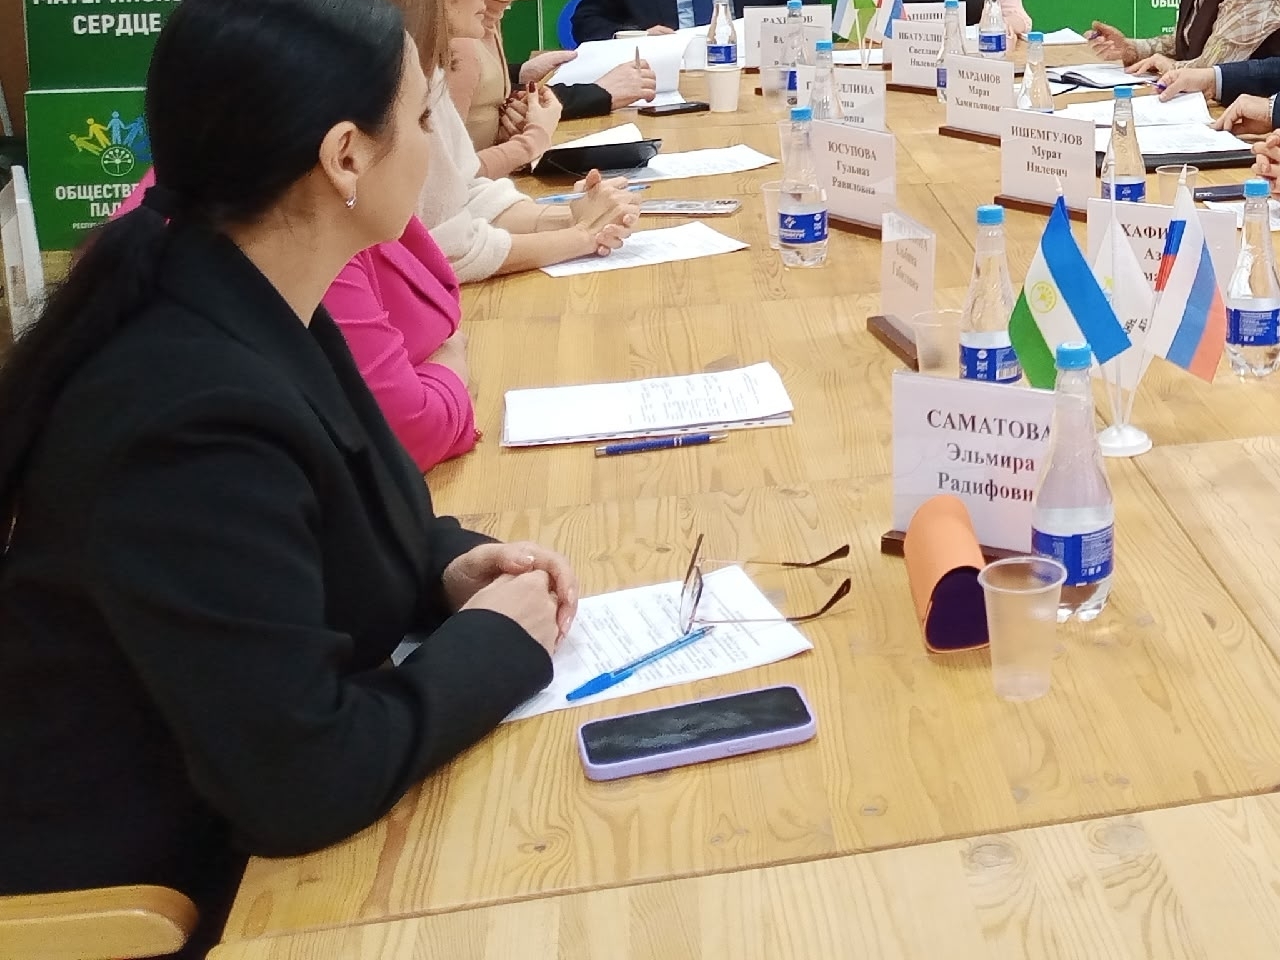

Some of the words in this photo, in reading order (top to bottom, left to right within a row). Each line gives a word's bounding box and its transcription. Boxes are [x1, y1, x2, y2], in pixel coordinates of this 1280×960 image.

[73, 13, 162, 37] СЕРДЦЕ
[958, 69, 1001, 85] МАРДАНОВ
[1011, 125, 1083, 146] ИШЕМГУЛОВ
[828, 140, 877, 161] ЮСУПОВА
[1031, 145, 1063, 161] Мурат
[836, 160, 870, 177] Гульназ
[946, 442, 1035, 475] Эльмира
[937, 471, 1034, 502] Радифовн
